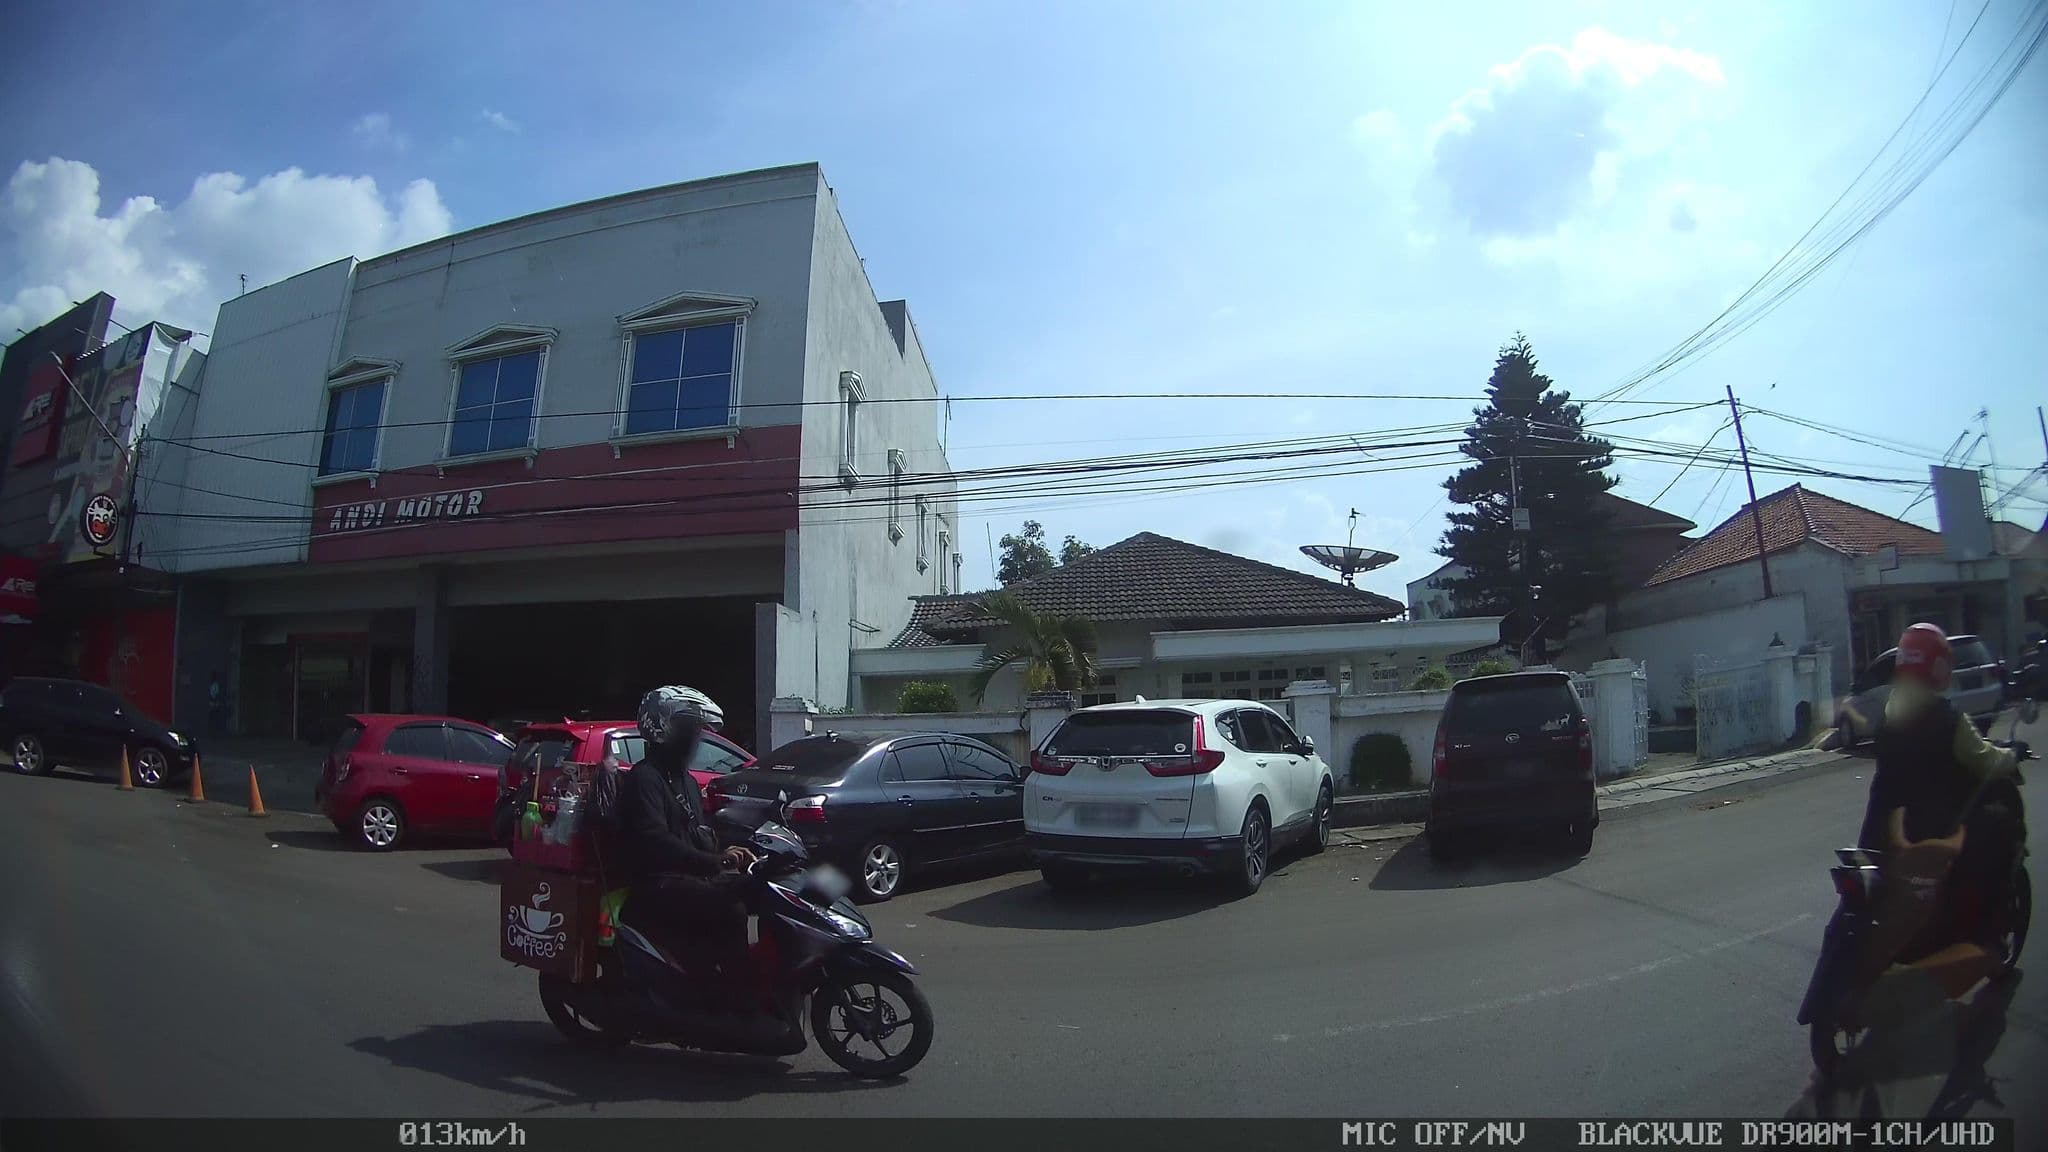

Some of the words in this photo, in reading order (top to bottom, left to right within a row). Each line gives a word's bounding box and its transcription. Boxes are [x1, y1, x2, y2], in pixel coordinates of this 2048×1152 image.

[329, 501, 386, 531] ANDI
[394, 490, 483, 524] MOTOR
[507, 924, 556, 959] Coffee
